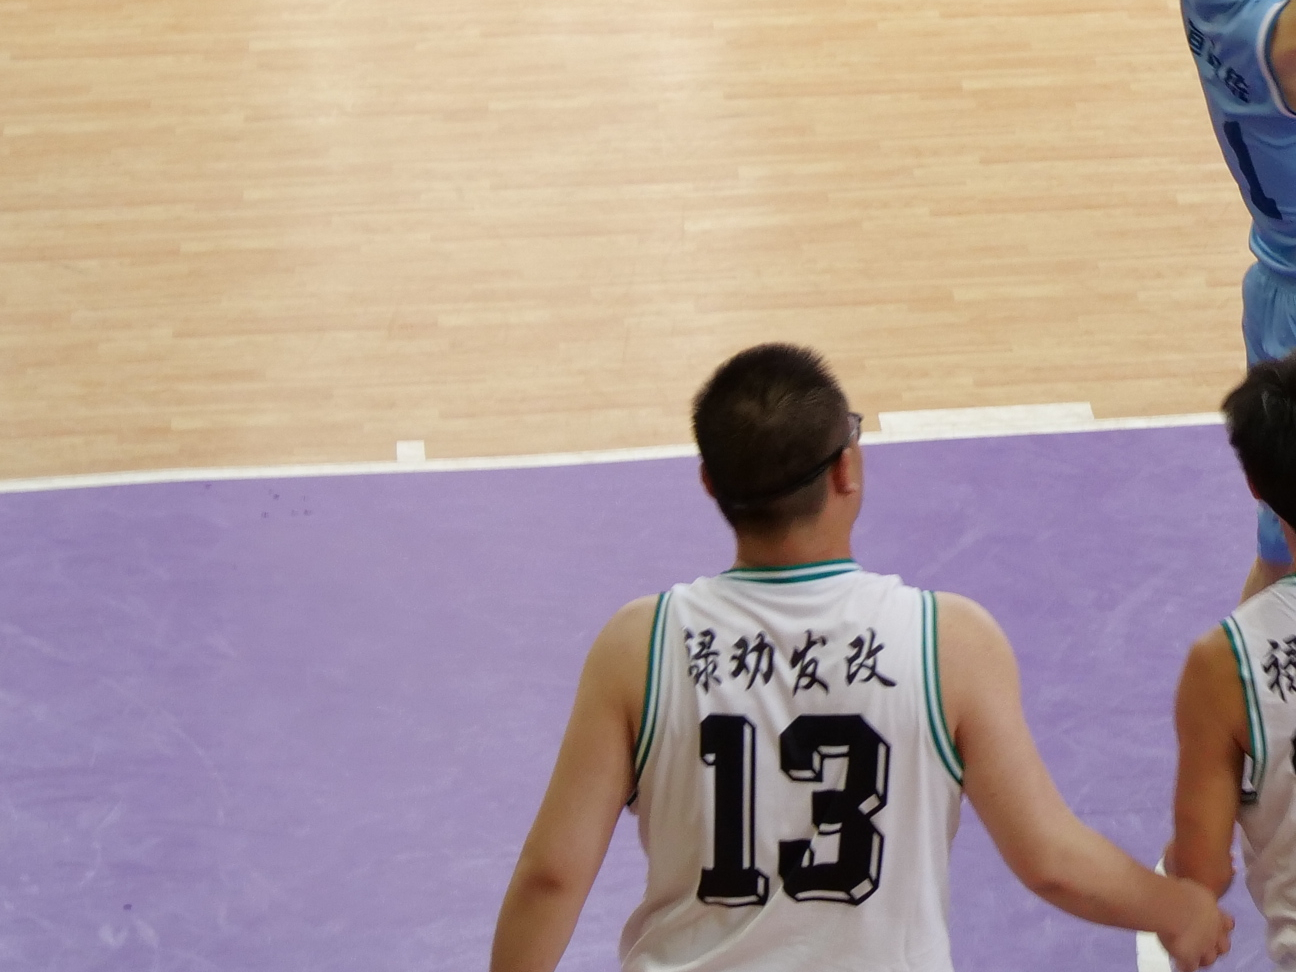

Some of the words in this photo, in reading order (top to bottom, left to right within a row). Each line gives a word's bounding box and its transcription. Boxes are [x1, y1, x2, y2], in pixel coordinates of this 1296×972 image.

[1223, 120, 1283, 221] 1
[683, 627, 897, 697] 禄劝发改
[697, 713, 891, 907] 13
